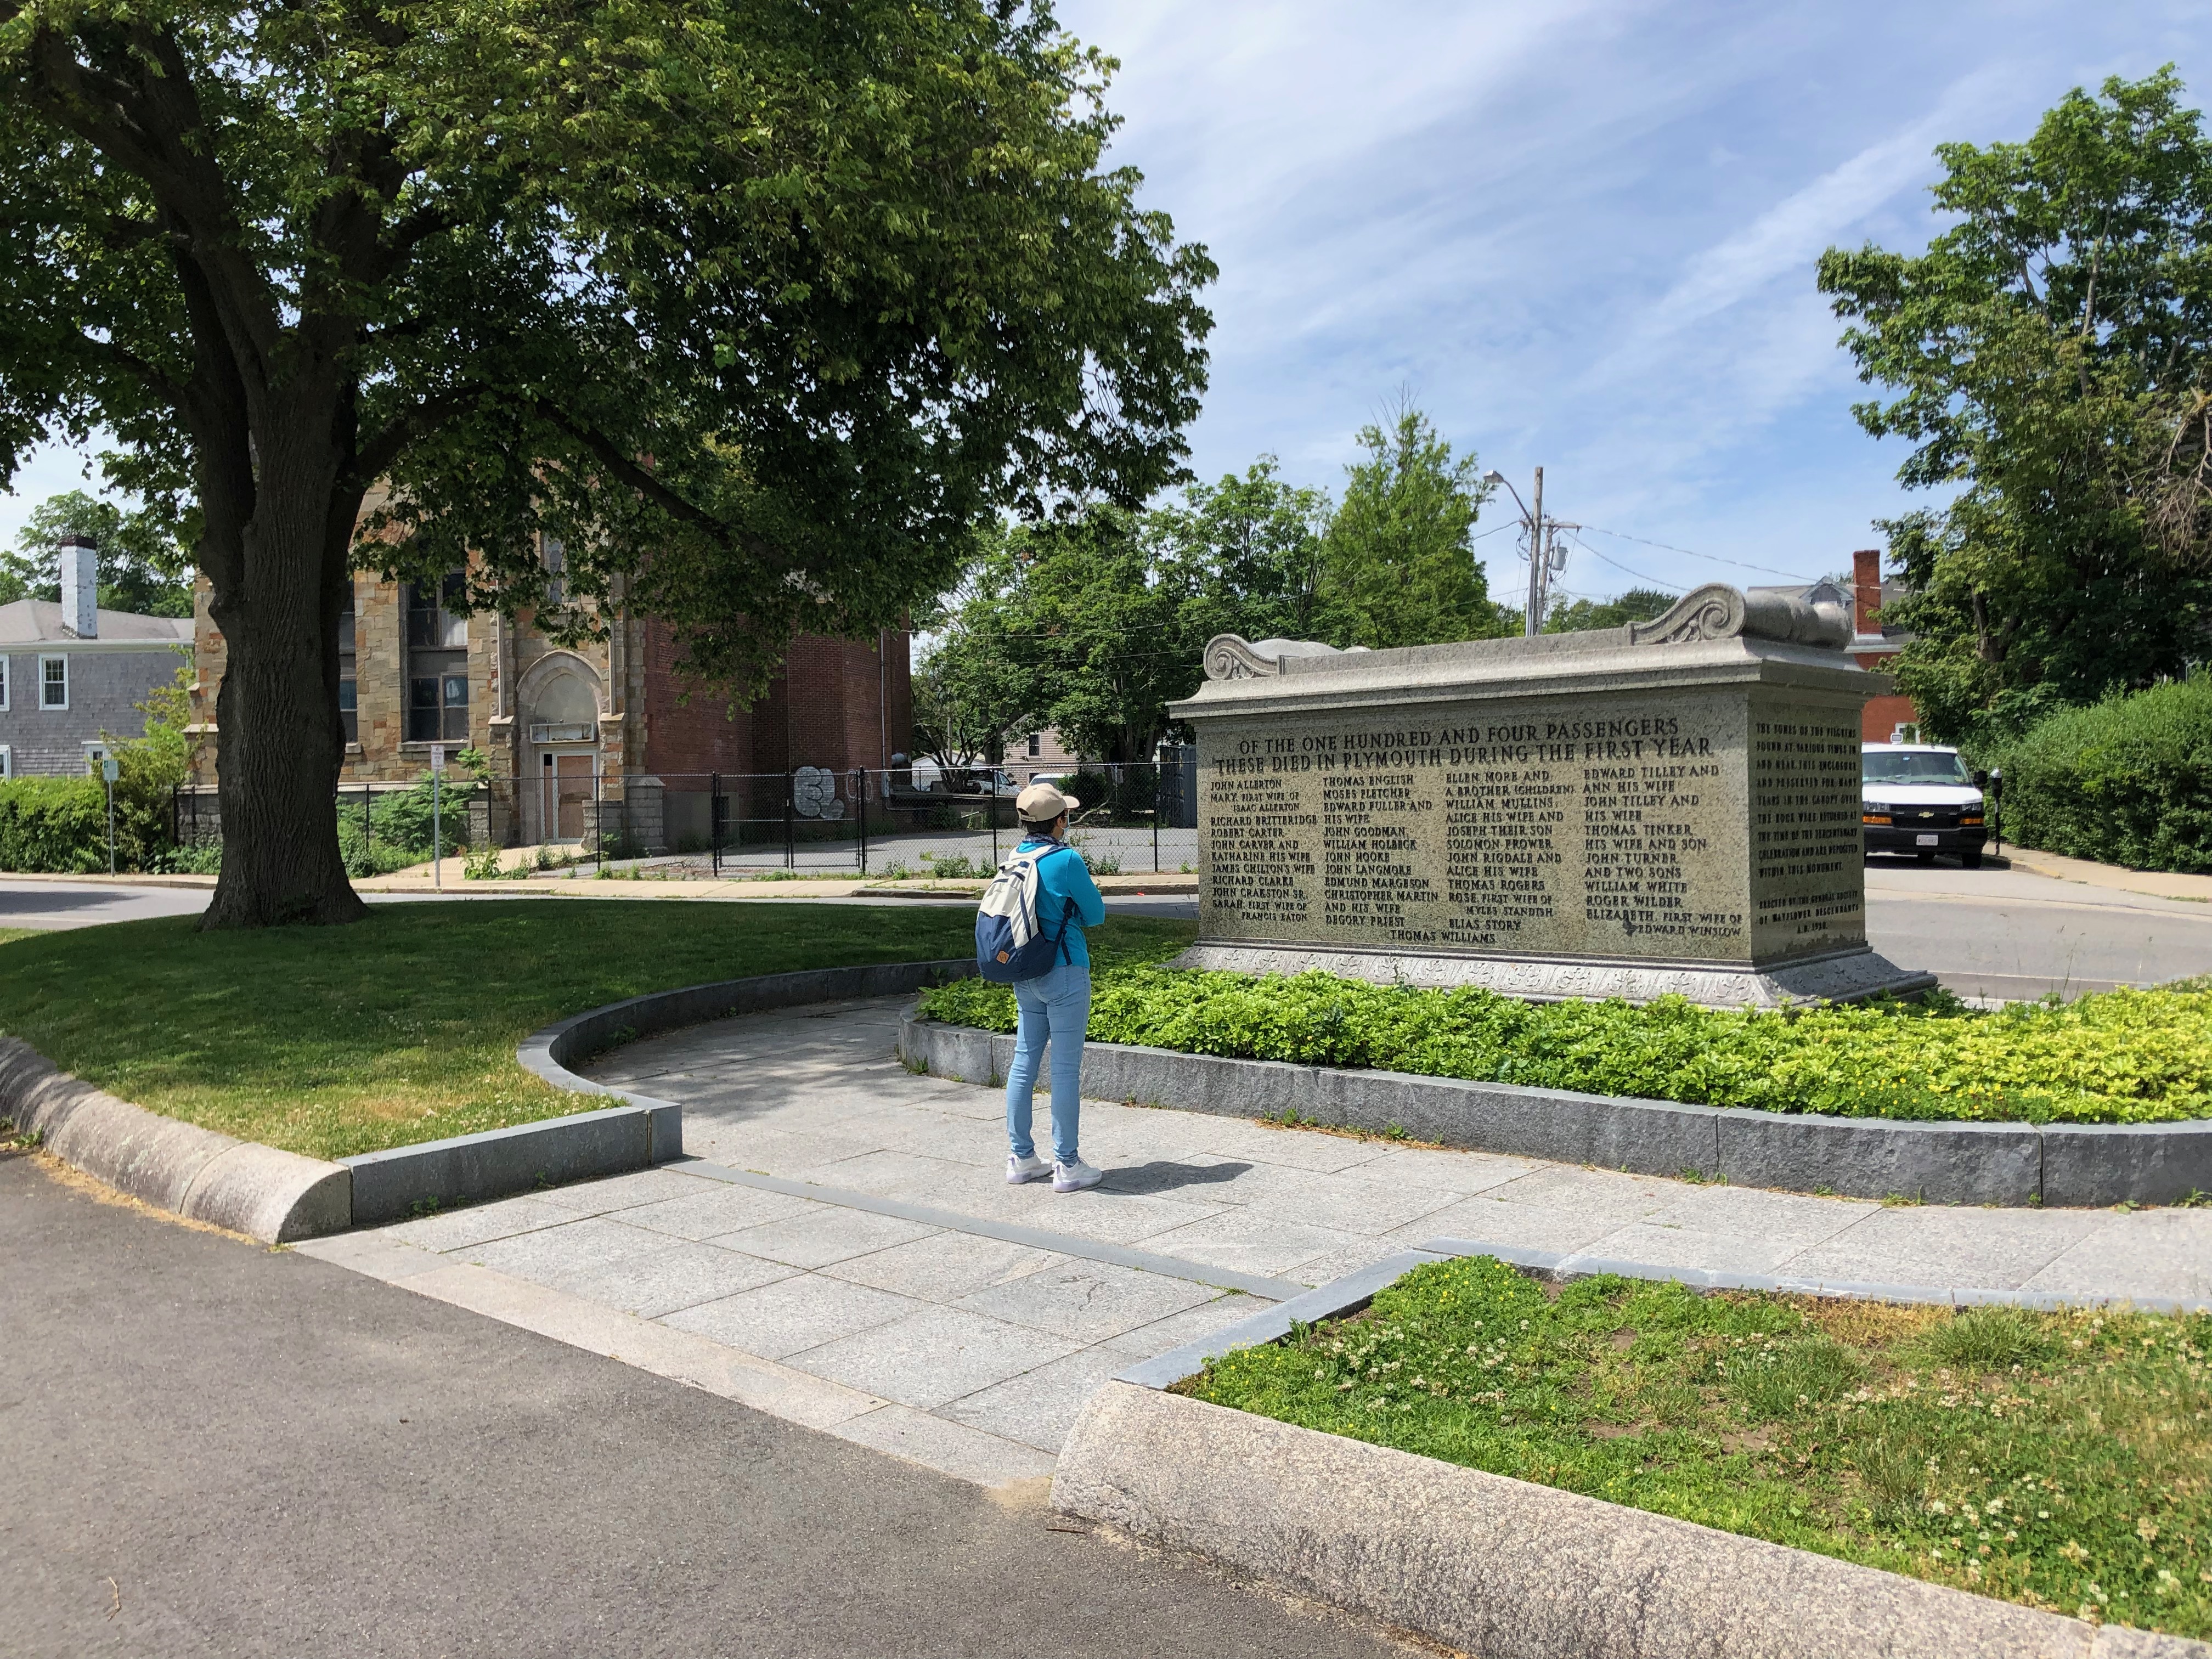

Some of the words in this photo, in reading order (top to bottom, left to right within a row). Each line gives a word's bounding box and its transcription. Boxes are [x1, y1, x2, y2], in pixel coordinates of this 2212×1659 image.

[1239, 740, 1259, 754] OF
[1265, 738, 1295, 753] THE
[1302, 736, 1336, 752] ONE
[1344, 731, 1431, 749] HUNDRED
[1440, 726, 1480, 745] AND
[1488, 725, 1537, 742] FOUR
[1547, 718, 1679, 739] PASSENGERS
[1216, 756, 1263, 776] THESE
[1272, 755, 1311, 773] DIED
[1318, 753, 1335, 770] IN
[1344, 749, 1442, 770] PLYMOUTH
[1450, 744, 1529, 766] DURING
[1537, 743, 1575, 761] THE
[1584, 740, 1644, 760] FIRST
[1649, 737, 1714, 757] YEAR
[1446, 772, 1479, 784] ELLEN
[1485, 771, 1517, 782] MORE
[1523, 770, 1550, 782] AND
[1584, 768, 1635, 780] EDWARD
[1641, 766, 1686, 778] TILLEY
[1689, 765, 1719, 777] AND
[1210, 781, 1234, 791] JOHN
[1237, 779, 1282, 789] ALLERTON
[1323, 776, 1364, 787] THOMAS
[1369, 775, 1414, 786] ENGLISH
[1583, 782, 1611, 794] ANN
[1618, 781, 1639, 793] HIS
[1645, 780, 1675, 793] WIFE
[1242, 793, 1262, 802] FIRST
[1266, 792, 1285, 800] WIFE
[1289, 792, 1299, 800] OF
[1323, 788, 1357, 800] MOSES
[1361, 788, 1410, 799] FLETCHER
[1445, 787, 1453, 797] A
[1458, 786, 1509, 797] BROTHER
[1233, 804, 1256, 812] ISAAC
[1259, 803, 1299, 812] ALLERTON
[1323, 802, 1365, 812] EDWARD
[1369, 800, 1406, 811] FULLER
[1409, 801, 1432, 811] AND
[1446, 798, 1494, 810] WILLIAM
[1584, 796, 1617, 808] JOHN
[1622, 795, 1666, 807] TILLEY
[1671, 795, 1699, 806] AND
[1210, 816, 1252, 827] RICHARD
[1324, 815, 1342, 825] HIS
[1345, 814, 1370, 824] WIFE
[1446, 812, 1477, 823] ALICE
[1483, 812, 1502, 823] HIS
[1506, 811, 1534, 822] WIFE
[1539, 811, 1564, 822] AND
[1585, 811, 1606, 822] HIS
[1612, 810, 1642, 822] WIFE
[1211, 827, 1245, 838] ROBERT
[1324, 827, 1350, 837] JOHN
[1447, 826, 1486, 837] JOSEPH
[1491, 825, 1526, 836] THEIR
[1530, 825, 1553, 836] SON
[1584, 825, 1637, 836] THOMAS
[1211, 840, 1234, 850] JOHN
[1239, 840, 1274, 849] CARVER
[1278, 840, 1299, 850] AND
[1323, 839, 1367, 850] WILLIAM
[1447, 839, 1500, 850] SOLOMON
[1585, 839, 1606, 850] HIS
[1612, 839, 1643, 850] WIFE
[1649, 839, 1676, 850] AND
[1681, 838, 1707, 850] SON
[1212, 852, 1265, 862] KATHARINE
[1269, 853, 1285, 862] HIS
[1288, 853, 1310, 863] WIFE
[1325, 852, 1351, 862] JOHN
[1356, 852, 1390, 863] HOOKE
[1447, 852, 1477, 864] JOHN
[1483, 853, 1533, 864] RIGDALE
[1537, 853, 1562, 864] AND
[1585, 853, 1618, 864] JOHN
[1626, 853, 1678, 865] TURNER
[1212, 864, 1240, 873] JAMES
[1244, 864, 1290, 874] CHILTON'S
[1293, 864, 1315, 874] WIFE
[1325, 864, 1351, 875] JOHN
[1356, 865, 1412, 876] LANGMORE
[1447, 866, 1479, 877] ALICE
[1484, 866, 1504, 877] HIS
[1509, 866, 1538, 877] WIFE
[1584, 867, 1611, 877] AND
[1616, 866, 1643, 878] TWO
[1649, 867, 1681, 878] SONS
[1212, 876, 1254, 886] RICHARD
[1259, 877, 1294, 887] CLARKE
[1324, 877, 1368, 888] EDMUND
[1372, 878, 1430, 889] MARGESON
[1448, 879, 1495, 890] THOMAS
[1500, 879, 1545, 891] ROGERS
[1584, 881, 1639, 892] WILLIAM
[1647, 882, 1688, 893] WHITE
[1212, 887, 1236, 897] JOHN
[1324, 890, 1393, 901] CHRISTOPHER
[1397, 891, 1438, 902] MARTIN
[1482, 894, 1508, 904] FIRST
[1513, 894, 1537, 904] WIFE
[1541, 895, 1552, 905] OF
[1587, 895, 1628, 906] ROGER
[1633, 896, 1683, 908] WILDER
[1249, 901, 1269, 910] FIRST
[1274, 902, 1294, 911] WIFE
[1297, 902, 1306, 911] OF
[1325, 902, 1346, 912] AND
[1352, 903, 1369, 913] HIS
[1375, 904, 1400, 914] WIFE
[1466, 906, 1498, 915] MYLES
[1503, 907, 1553, 917] STANDISH
[1242, 912, 1277, 921] FRANCIS
[1280, 913, 1307, 922] EATON
[1370, 916, 1406, 928] PRIEST
[1663, 912, 1692, 923] FIRST
[1699, 913, 1726, 924] WIFE
[1729, 914, 1742, 924] OF
[1449, 919, 1480, 930] ELIAS
[1485, 919, 1521, 931] STORY
[1639, 924, 1685, 934] EDWARD
[1689, 926, 1741, 936] WINSLOW
[1390, 930, 1436, 941] THOMAS
[1441, 932, 1496, 943] WILLIAMS
